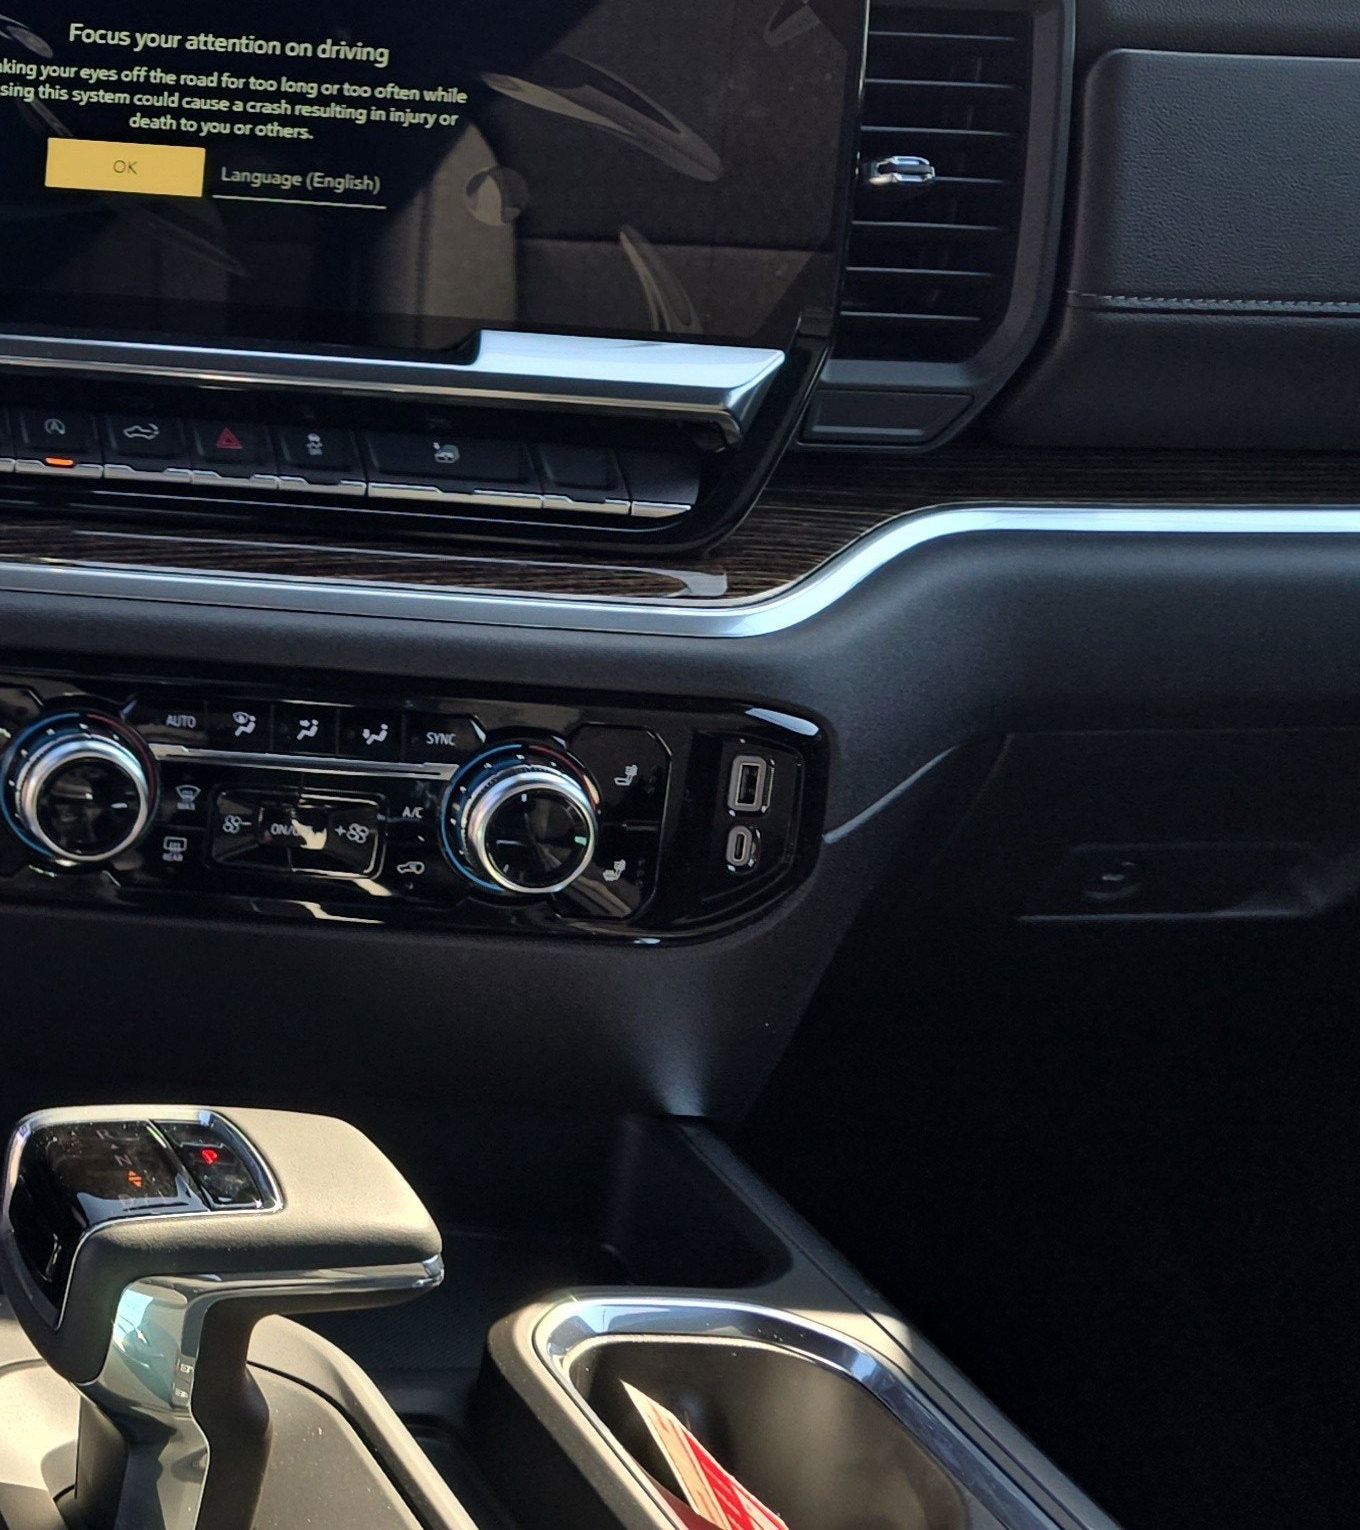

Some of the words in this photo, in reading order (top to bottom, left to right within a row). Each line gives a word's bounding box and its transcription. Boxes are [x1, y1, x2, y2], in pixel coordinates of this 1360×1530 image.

[68, 23, 130, 46] Focus
[133, 32, 182, 52] your
[184, 32, 281, 55] attention
[285, 41, 313, 58] on
[316, 38, 390, 68] driving
[40, 64, 78, 81] your
[79, 66, 118, 83] eyes
[121, 67, 148, 82] off
[149, 68, 177, 85] the
[180, 72, 218, 88] road
[220, 72, 245, 89] for
[248, 76, 278, 91] too
[280, 76, 318, 98] long
[320, 82, 341, 95] or
[343, 82, 372, 97] too
[374, 83, 420, 101] often
[423, 86, 468, 103] while
[37, 84, 69, 101] this
[71, 88, 130, 106] system
[133, 92, 179, 108] could
[181, 96, 230, 111] cause
[232, 101, 244, 112] a
[246, 99, 291, 115] crash
[294, 103, 367, 124] resulting
[370, 107, 387, 122] in
[389, 108, 437, 129] injury
[438, 113, 459, 126] or
[129, 113, 177, 130] death
[179, 117, 198, 132] to
[199, 121, 231, 137] you
[233, 123, 254, 136] or
[255, 122, 315, 140] others.
[112, 159, 139, 175] OK
[221, 166, 302, 188] Language
[305, 172, 381, 195] (English)
[166, 714, 197, 729] AUTO
[426, 732, 456, 747] SYNC
[402, 805, 423, 820] A/C
